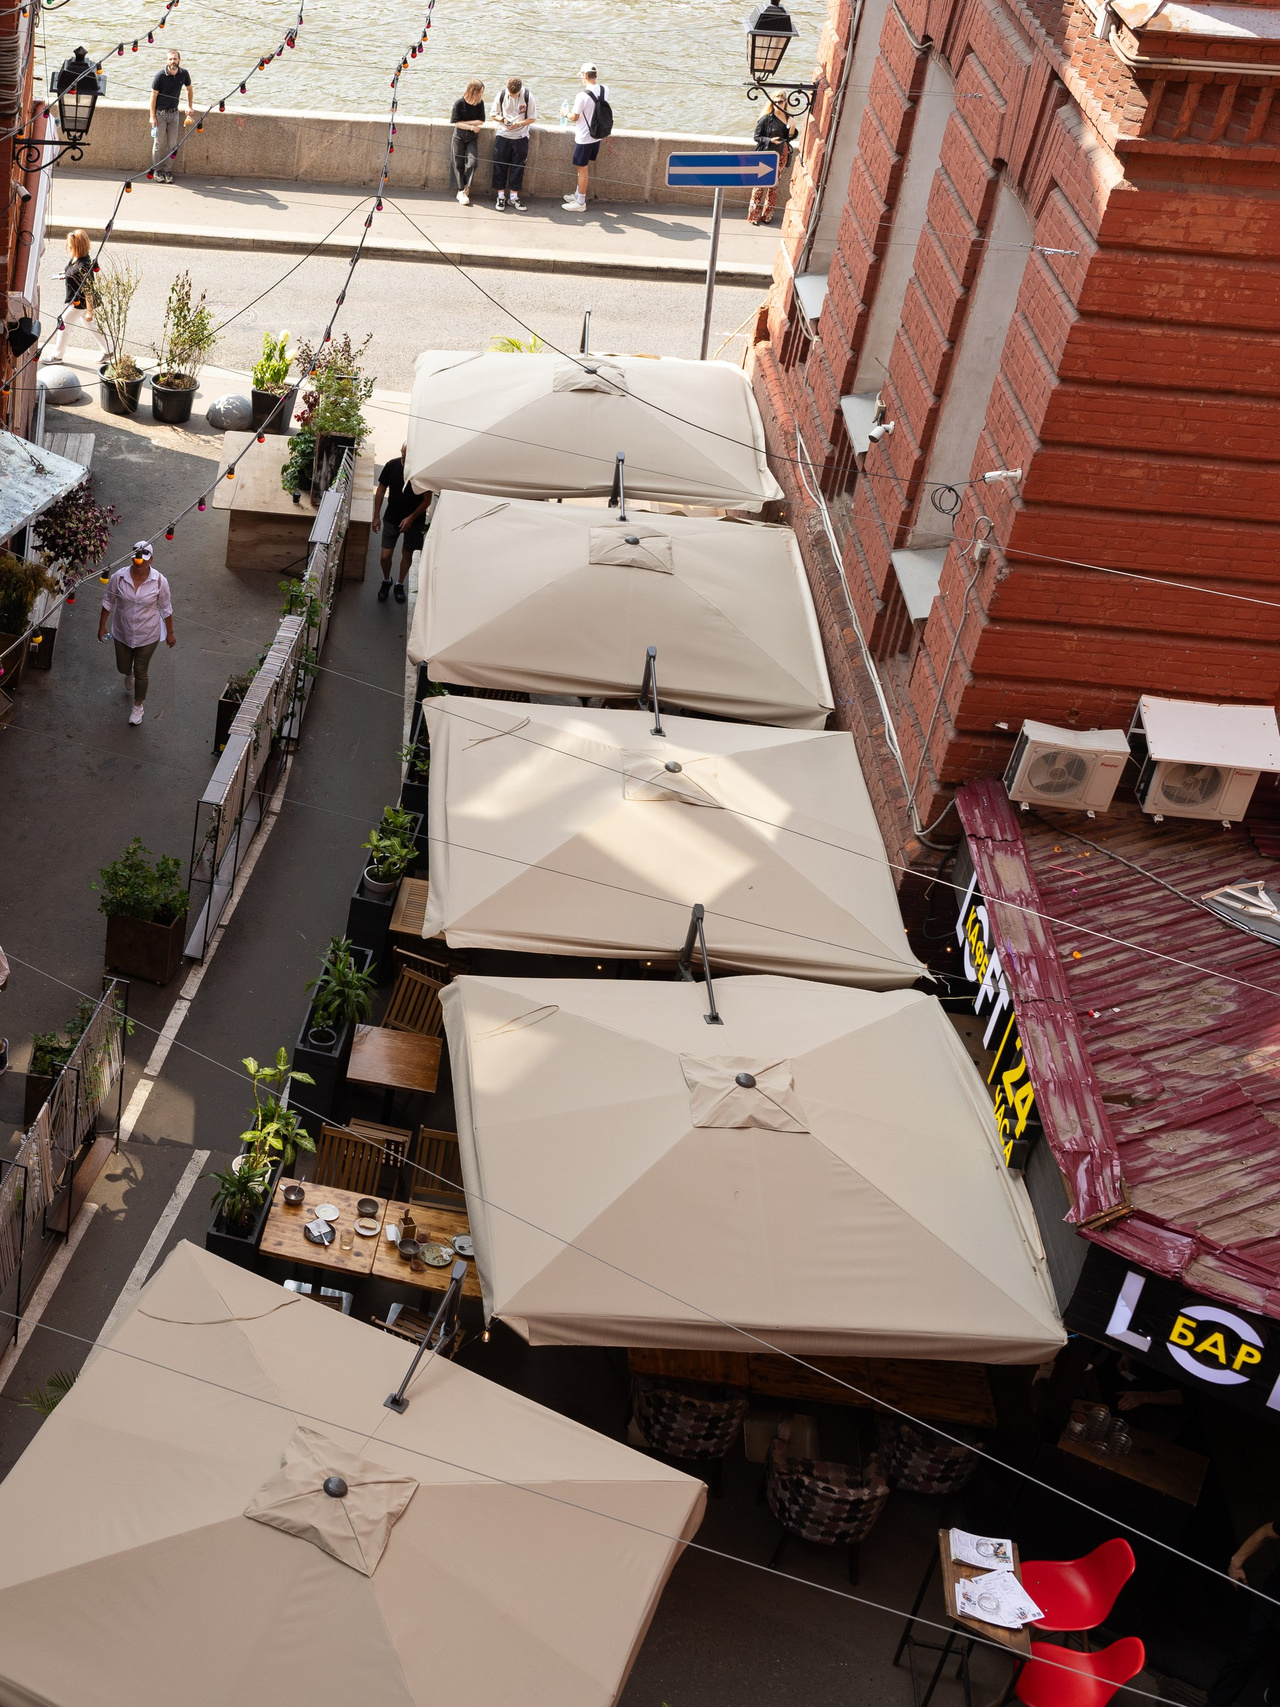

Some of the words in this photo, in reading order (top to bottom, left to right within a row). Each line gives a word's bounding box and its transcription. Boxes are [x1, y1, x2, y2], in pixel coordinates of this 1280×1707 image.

[966, 905, 989, 984] КАФЕ
[993, 1085, 1013, 1168] ЧАСА
[1002, 1037, 1034, 1139] 24
[1169, 1315, 1262, 1371] БАР
